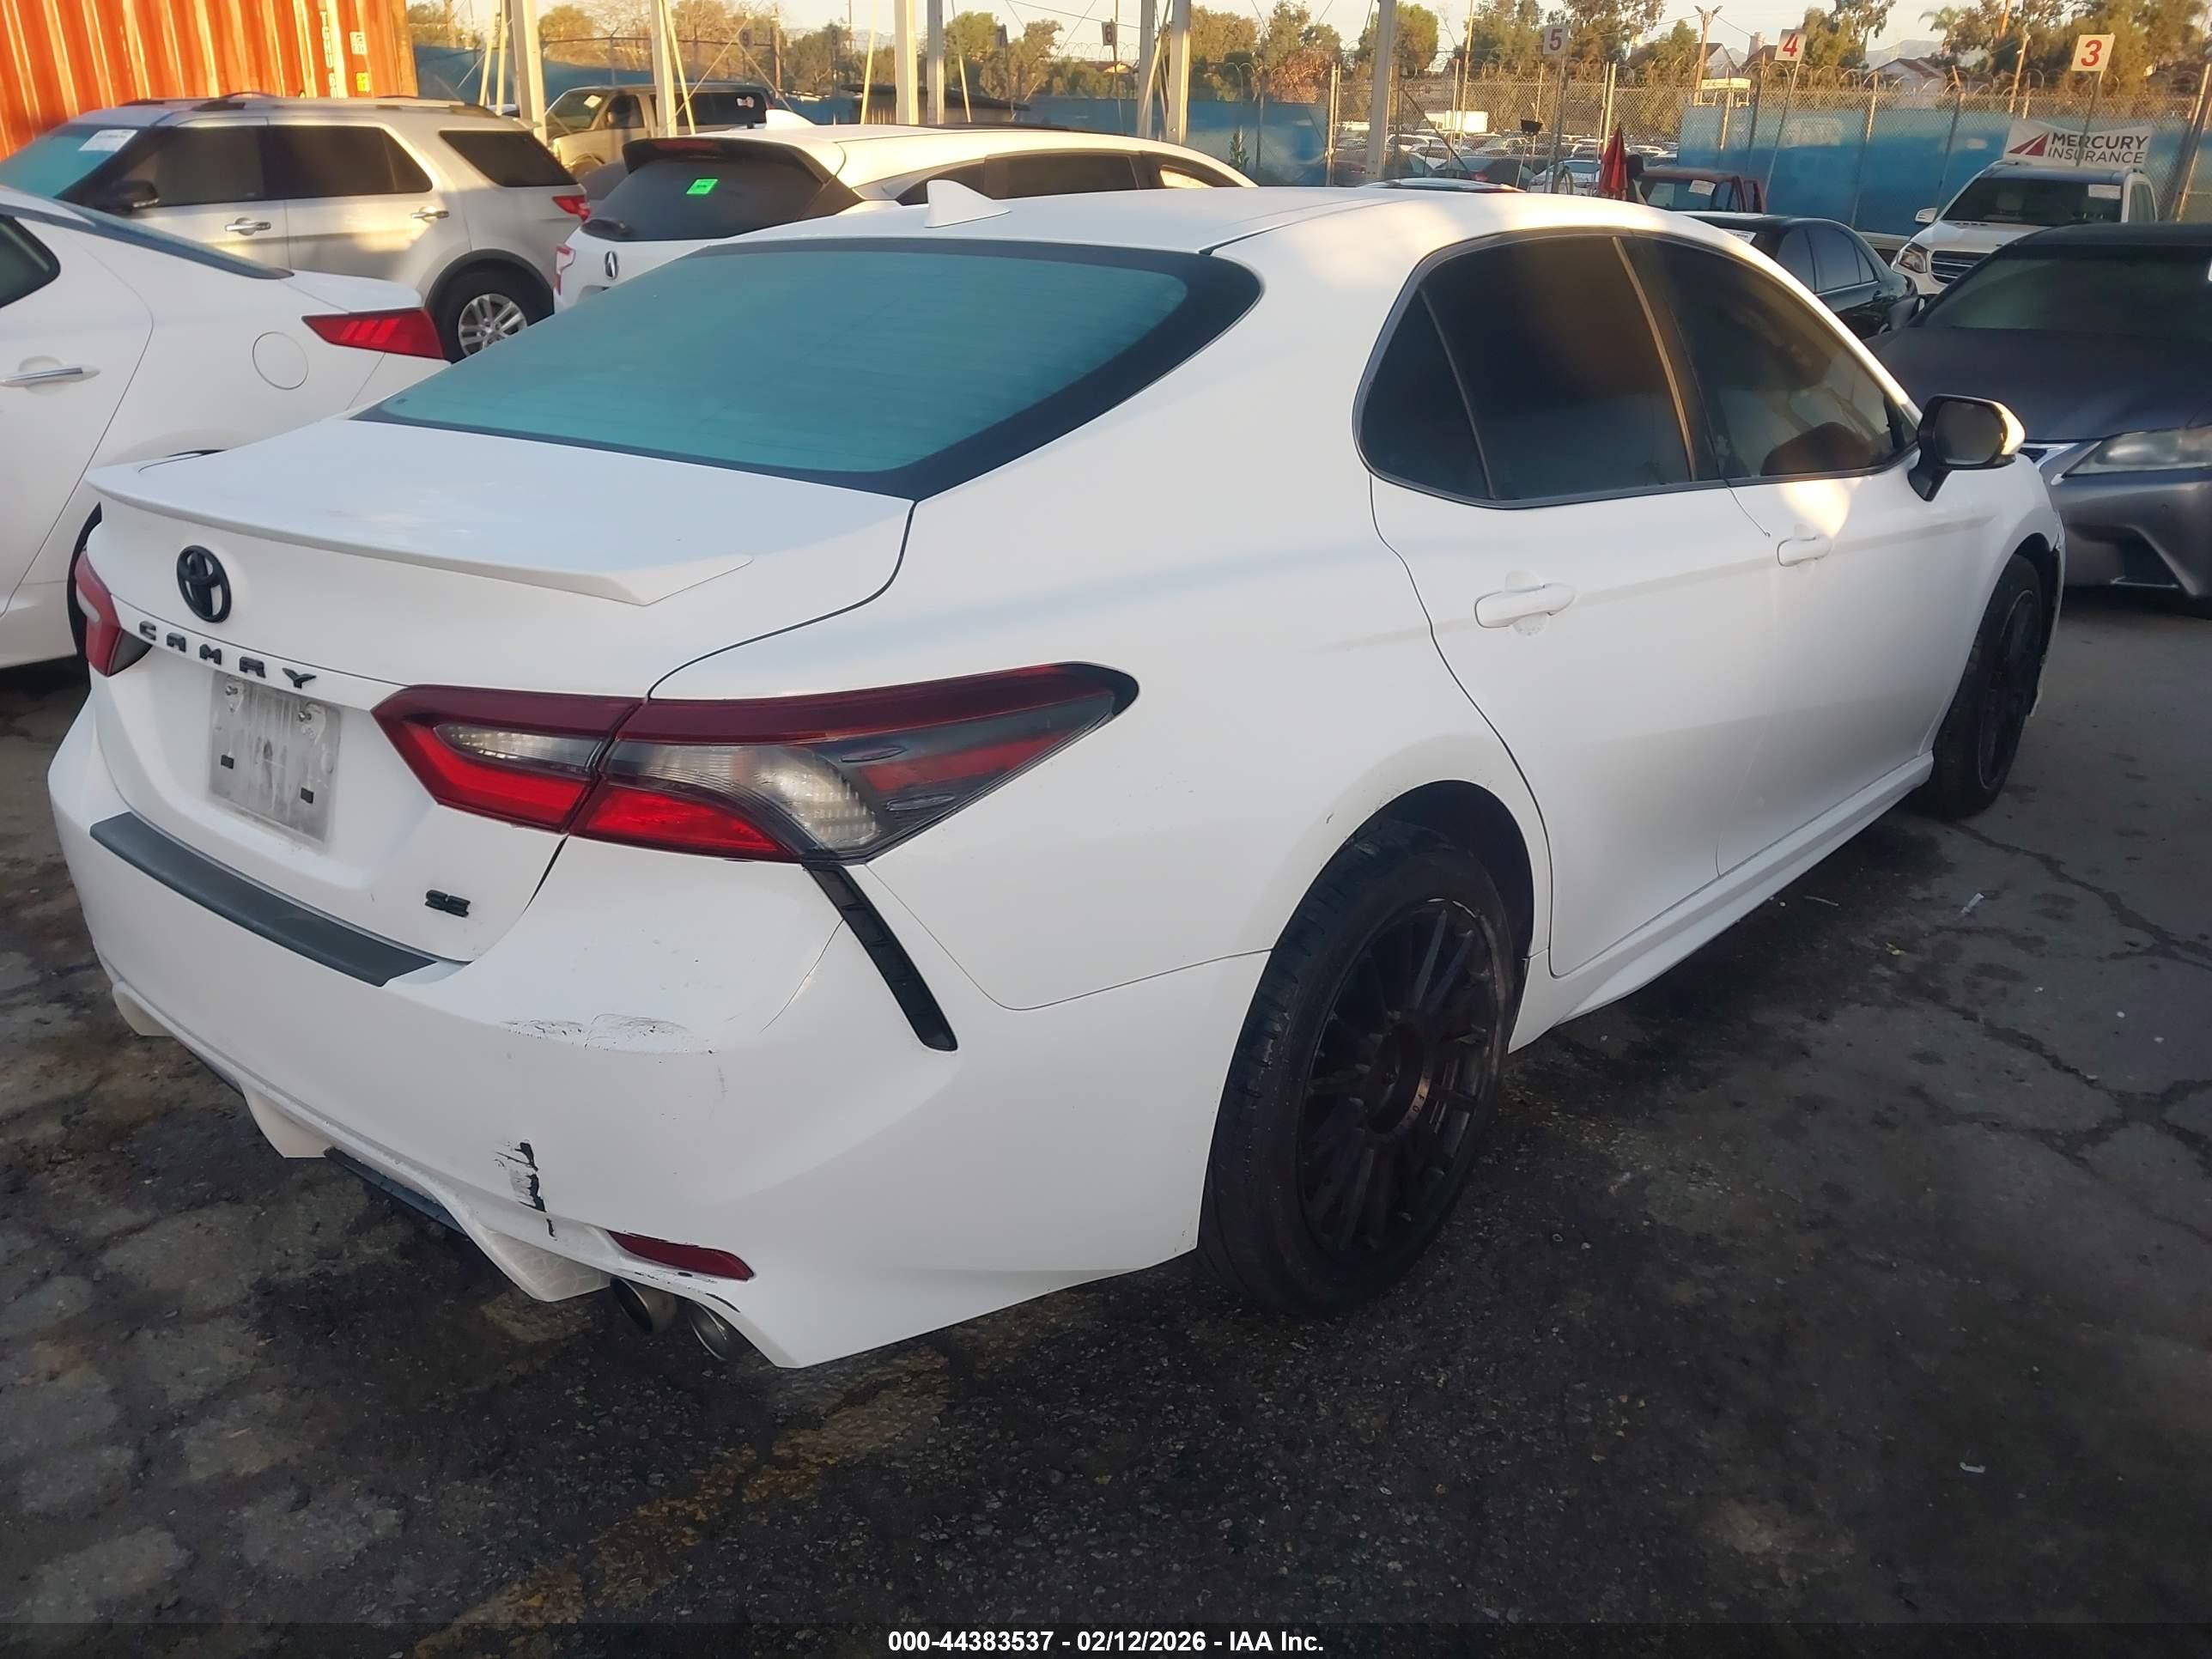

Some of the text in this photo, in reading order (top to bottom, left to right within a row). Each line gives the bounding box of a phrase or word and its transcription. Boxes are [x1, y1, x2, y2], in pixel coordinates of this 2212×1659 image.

[1549, 28, 1563, 51] 5
[1783, 33, 1797, 57] 4
[2081, 40, 2102, 67] 3
[2051, 132, 2148, 149] MERCURY
[2048, 147, 2145, 164] INSURANCE
[139, 620, 317, 689] CAMRY
[425, 890, 471, 918] SE
